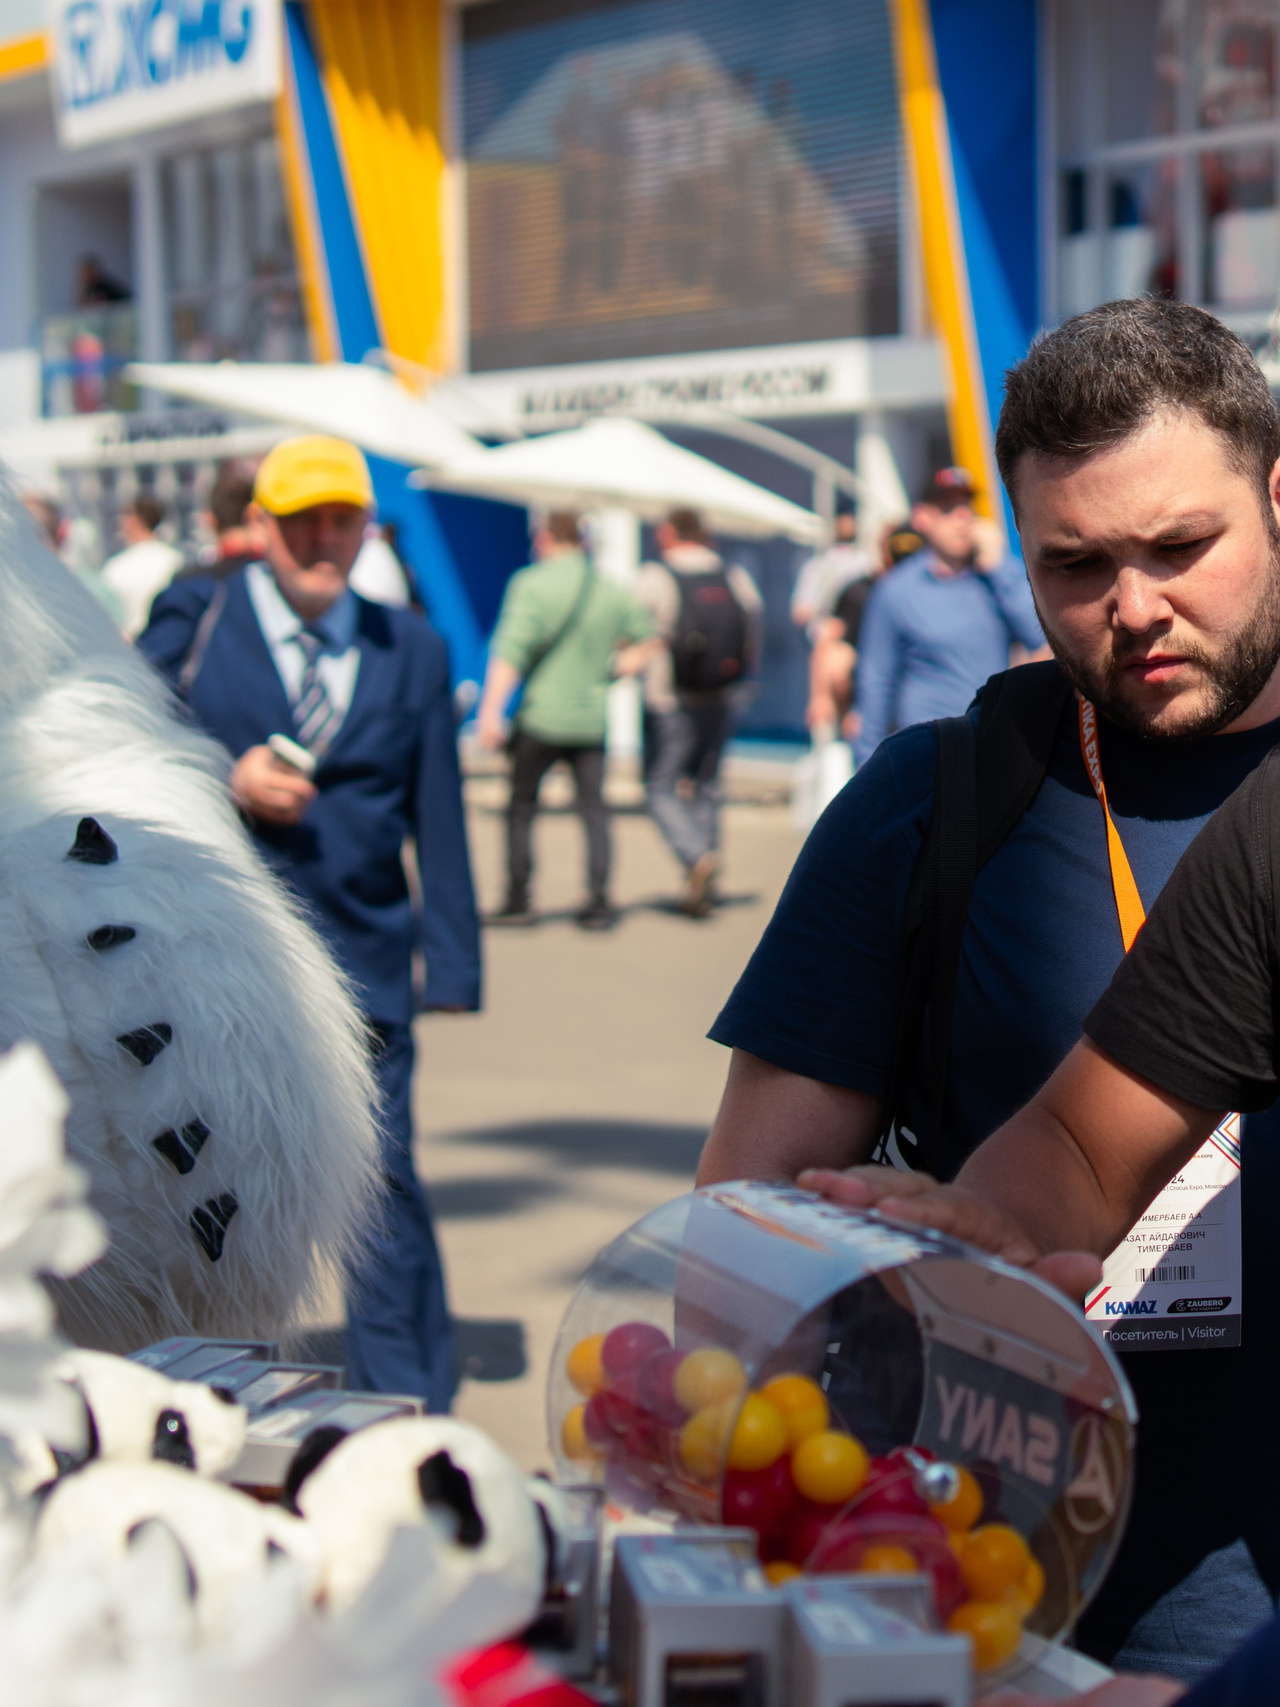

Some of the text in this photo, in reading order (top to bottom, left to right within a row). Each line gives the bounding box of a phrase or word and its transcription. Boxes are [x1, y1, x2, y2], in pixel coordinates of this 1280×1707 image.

[1171, 1174, 1185, 1184] 24
[1139, 1212, 1186, 1222] ИМЕРБАЕВ
[1123, 1230, 1206, 1243] АЗАТ АЙДАРОВИЧ
[1136, 1242, 1193, 1253] ТИМЕРБАЕВ
[1105, 1300, 1158, 1316] KAMAZ
[1186, 1299, 1224, 1308] ZAUBERG
[1102, 1329, 1179, 1341] Посетитель
[1187, 1326, 1227, 1339] Visitor
